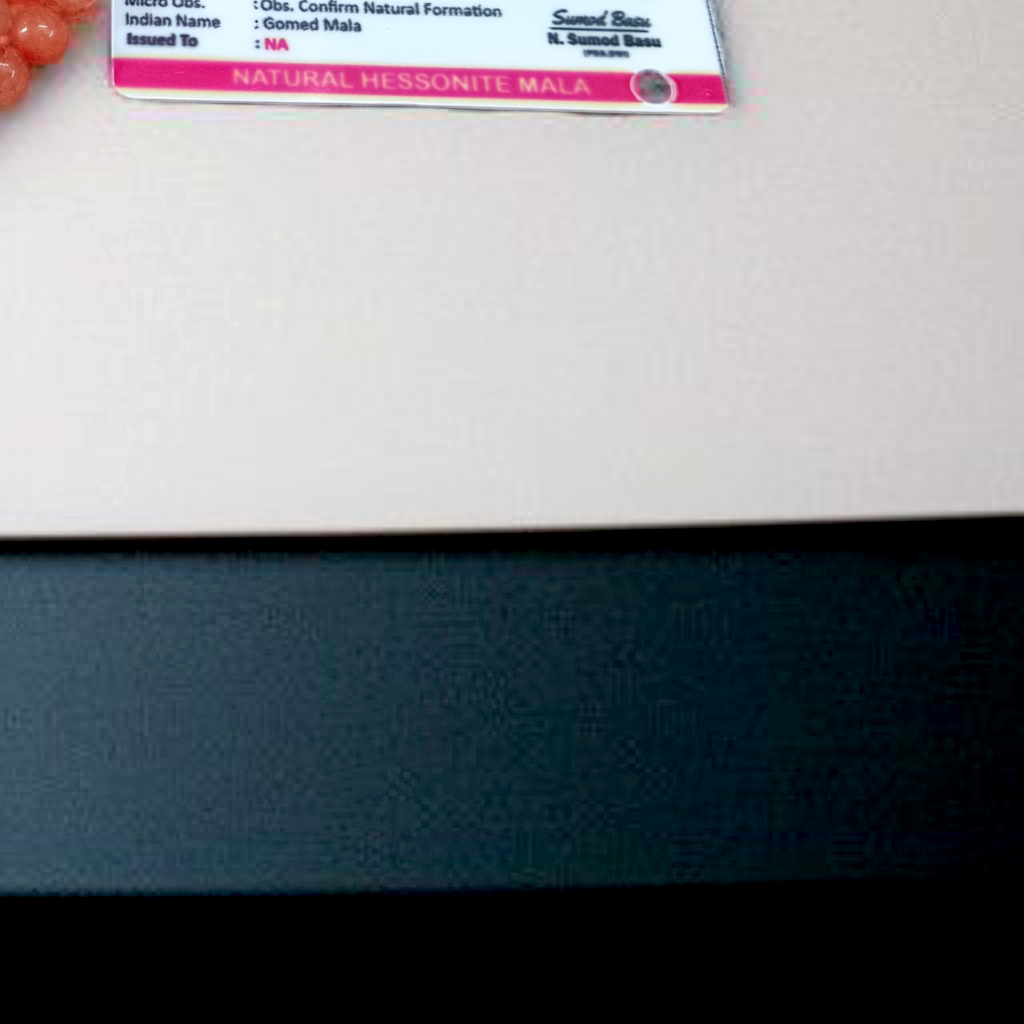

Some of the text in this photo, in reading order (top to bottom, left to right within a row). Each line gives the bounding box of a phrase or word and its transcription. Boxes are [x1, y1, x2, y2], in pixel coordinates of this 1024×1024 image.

[299, 1, 359, 14] Confirm
[364, 1, 419, 16] Natural
[424, 4, 502, 17] Formation
[552, 9, 651, 28] Sumod Basu
[126, 13, 172, 27] Indian
[176, 17, 220, 29] Name
[263, 18, 319, 31] Gomed
[324, 19, 361, 32] Mala
[127, 32, 176, 46] Issued
[180, 34, 198, 48] To
[264, 37, 289, 51] NA
[548, 32, 661, 47] N. Sumod Basu
[233, 68, 590, 95] NATURAL HESSONITE MALA
